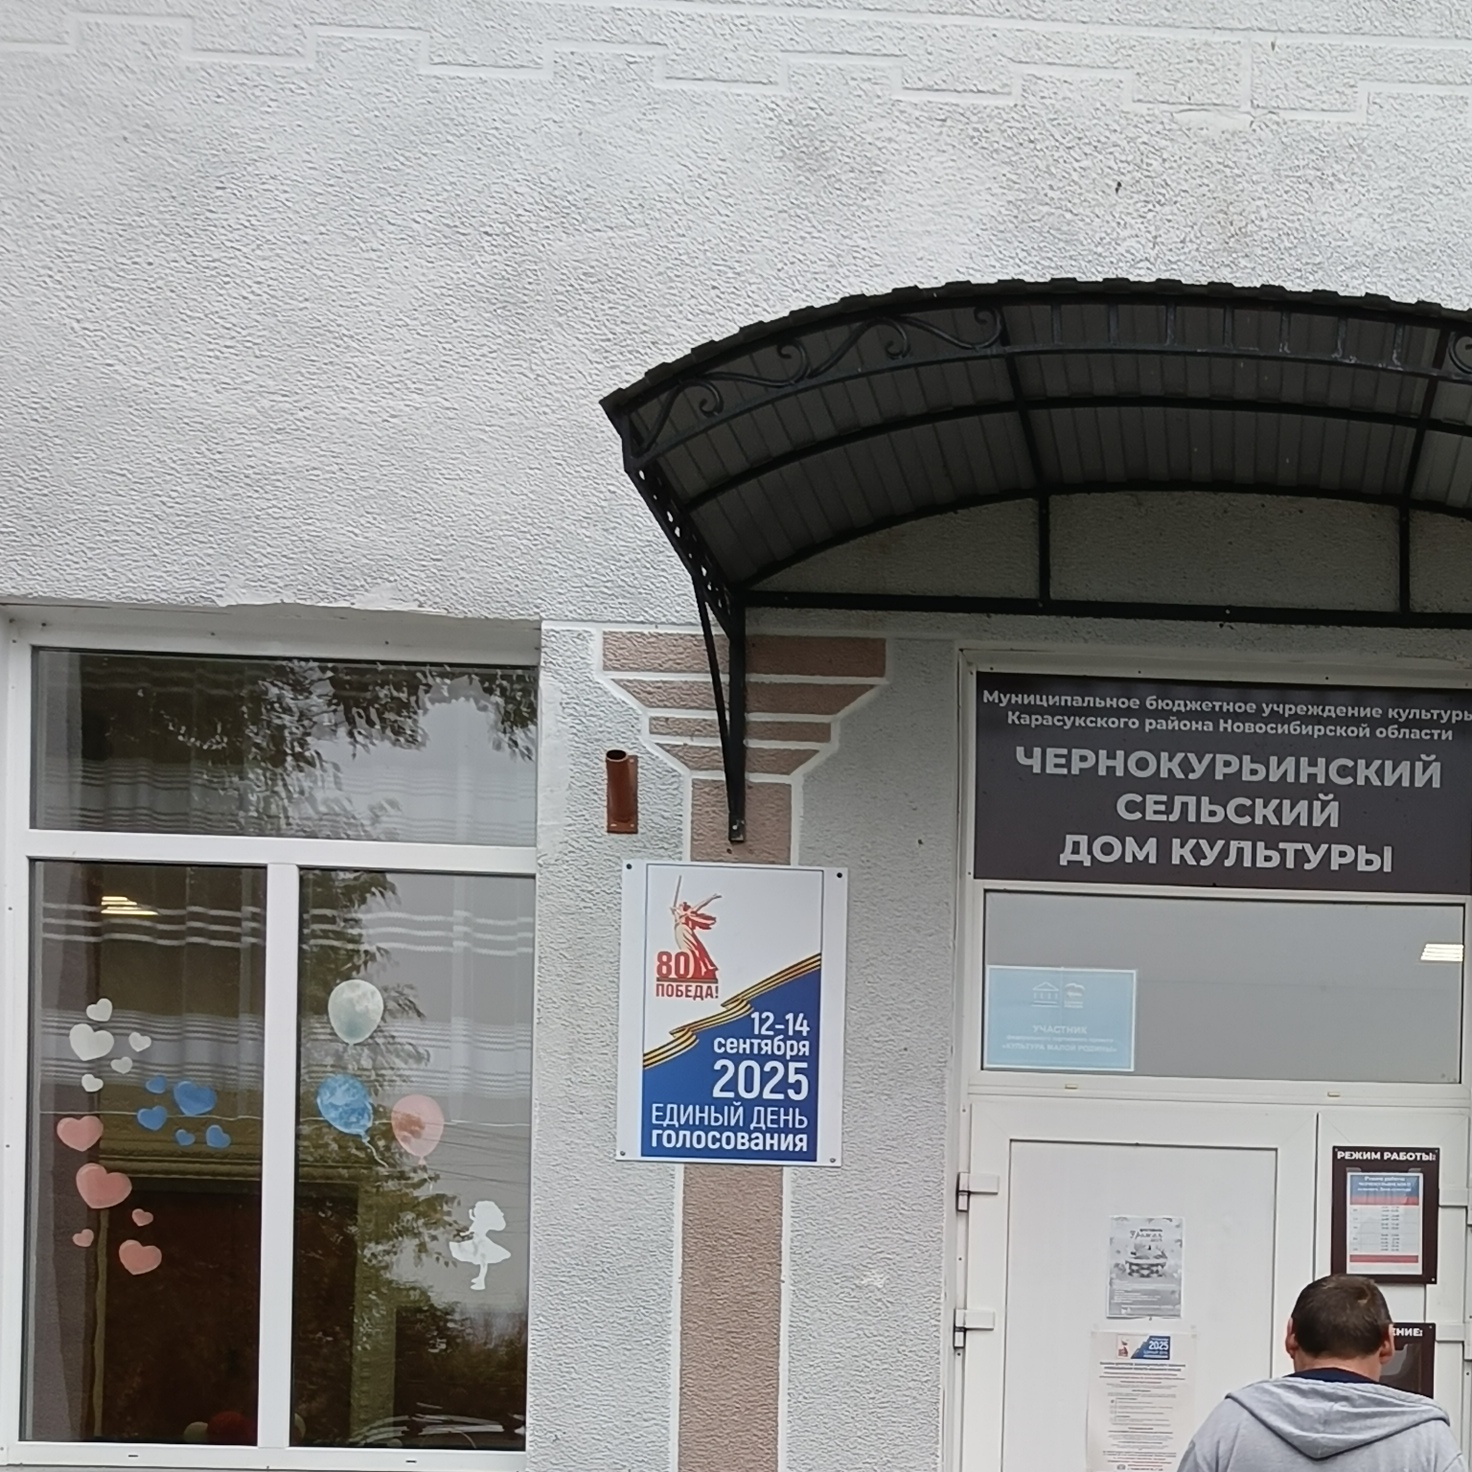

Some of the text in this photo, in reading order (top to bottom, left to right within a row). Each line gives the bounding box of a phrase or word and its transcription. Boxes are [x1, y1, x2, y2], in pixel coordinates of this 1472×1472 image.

[983, 690, 1140, 710] Муниципальное
[1145, 696, 1257, 714] бюджетное
[1262, 702, 1383, 718] учреждение
[1007, 711, 1454, 741] Карасукского района Новосибирской области
[1016, 746, 1442, 789] ЧЕРНОКУРЬИНСКИЙ
[1116, 793, 1340, 828] СЕЛЬСКИЙ
[1059, 834, 1393, 873] ДОМ КУЛЬТУРЫ
[656, 951, 690, 979] 80
[656, 982, 719, 1001] ПОБЕДА!
[751, 1011, 810, 1037] 12-14
[1032, 1025, 1088, 1034] УЧАСТНИК
[713, 1035, 810, 1059] сентября
[712, 1058, 809, 1101] 2025
[651, 1102, 808, 1130] ЕДИНЫЙ ДЕНЬ
[651, 1129, 808, 1151] голосования
[1337, 1151, 1381, 1160] РЕЖИМ
[1148, 1341, 1169, 1351] 2025
